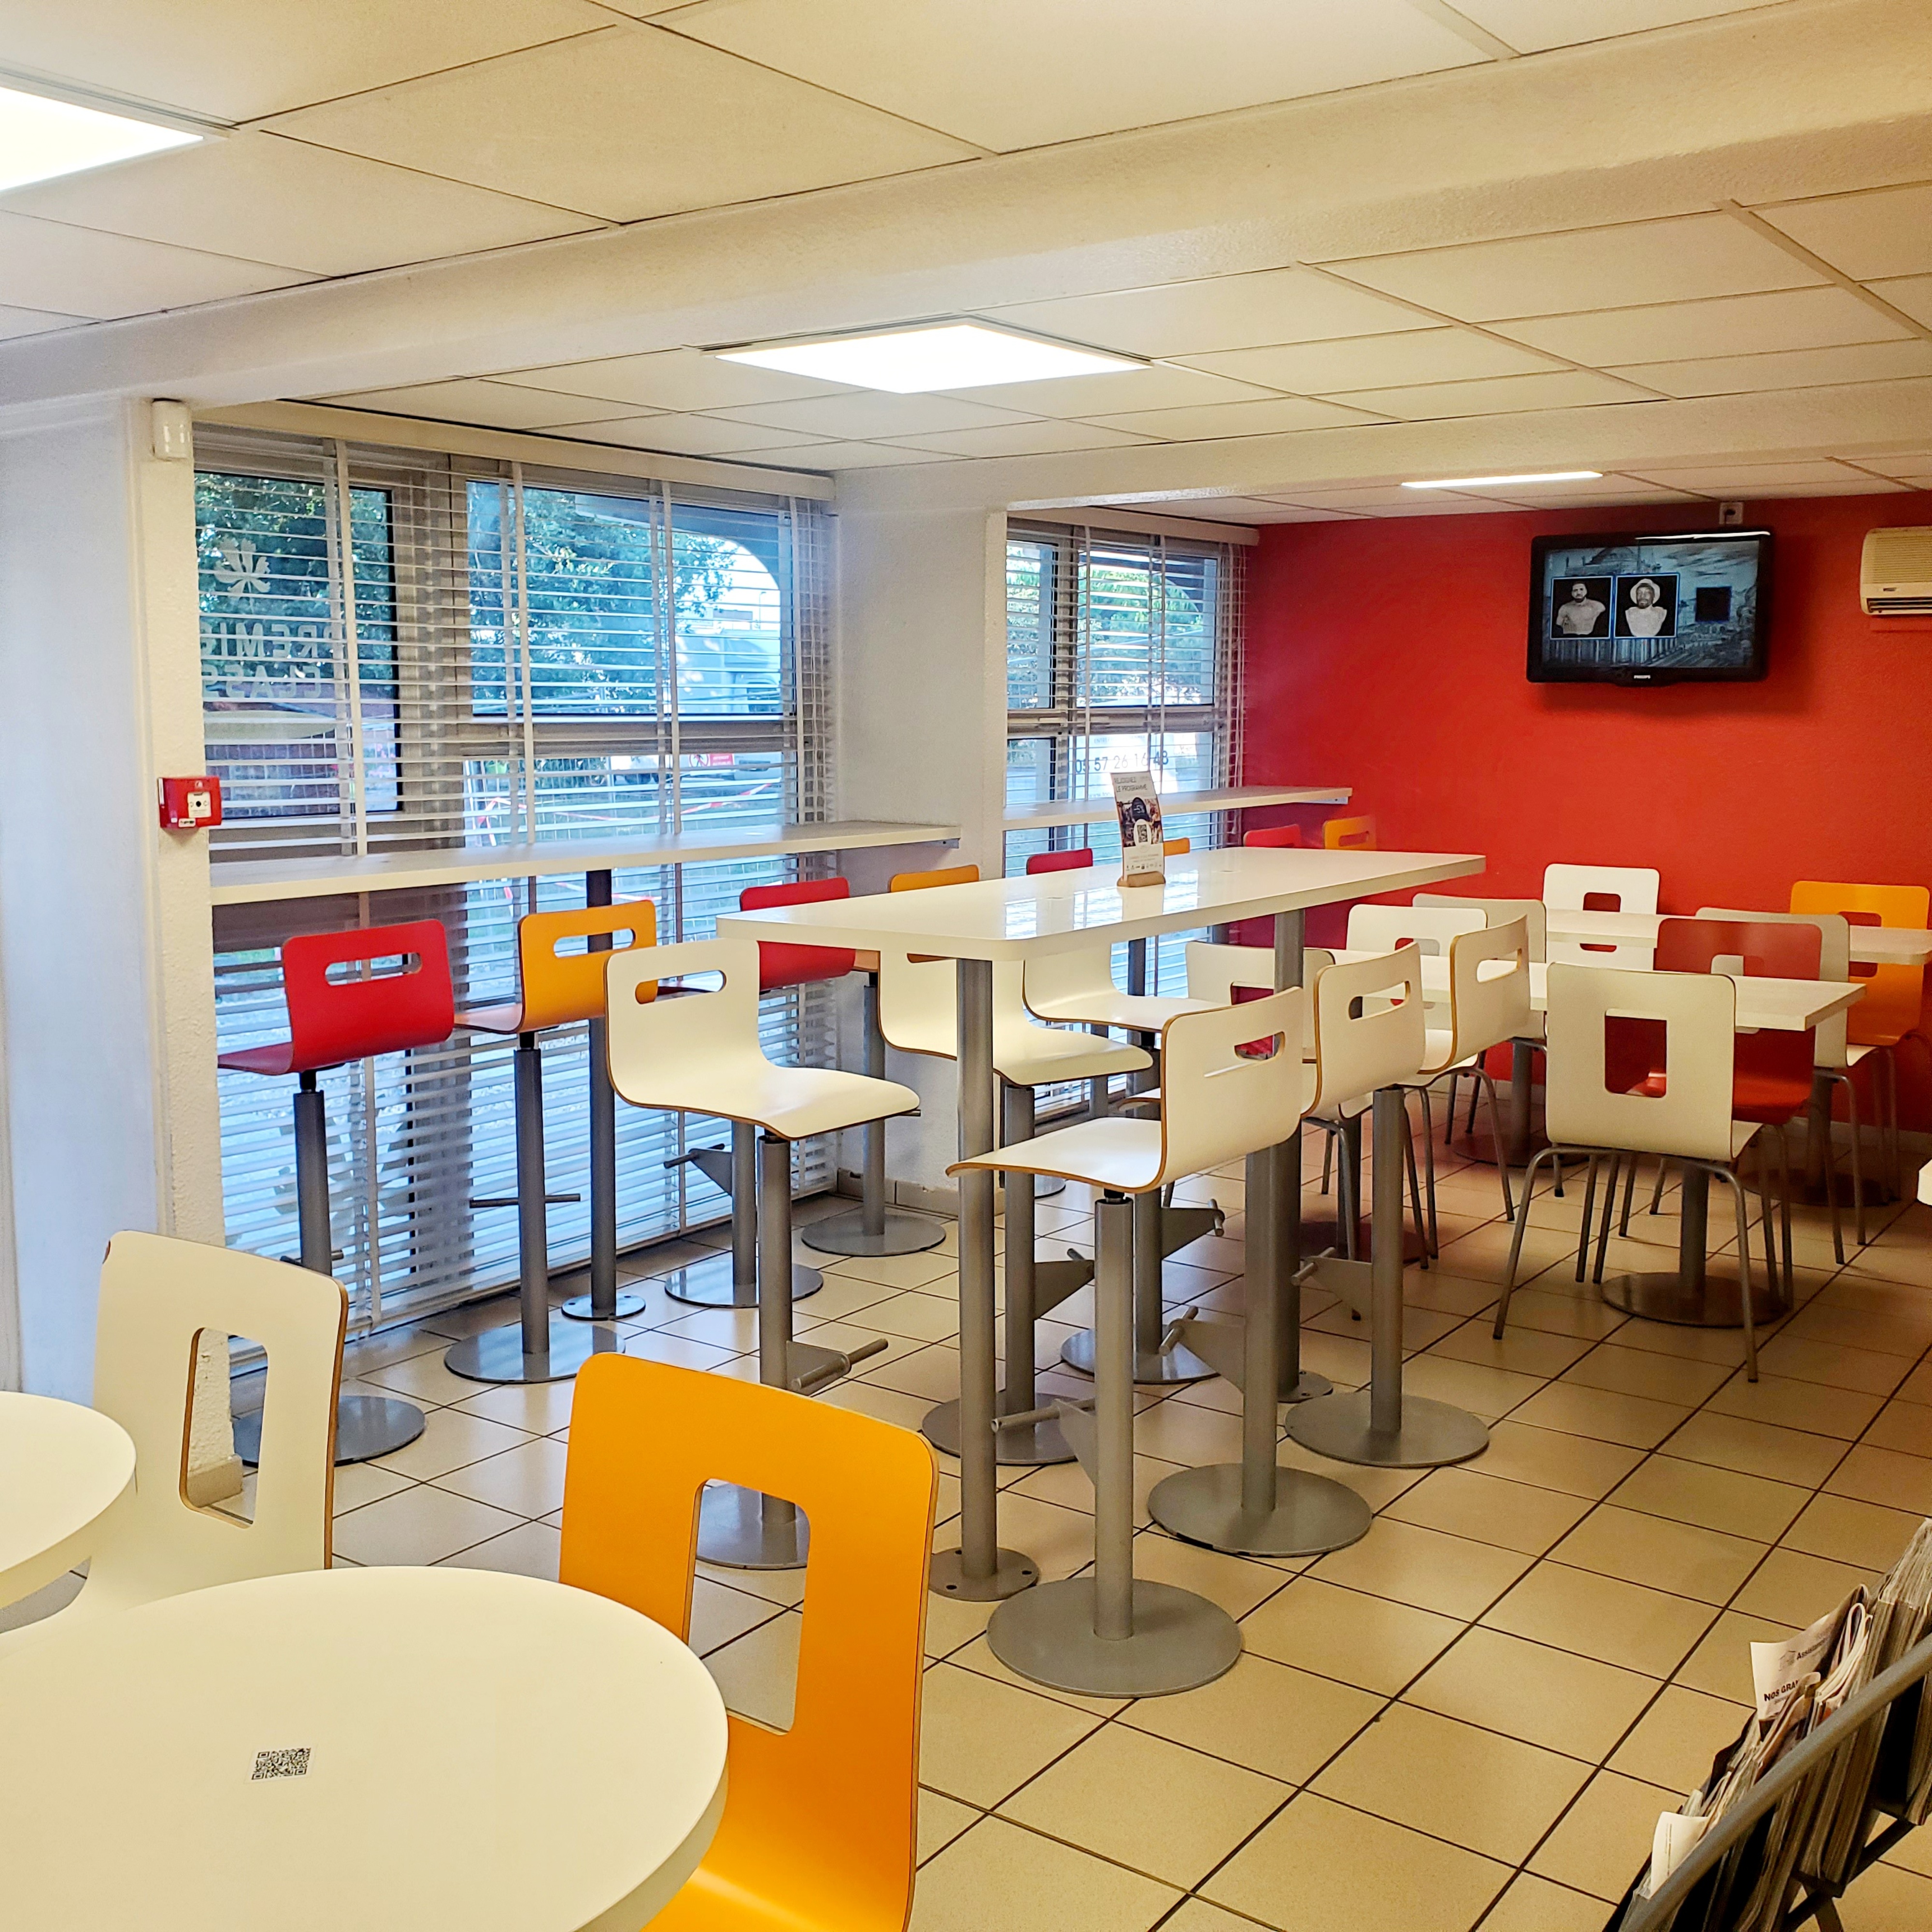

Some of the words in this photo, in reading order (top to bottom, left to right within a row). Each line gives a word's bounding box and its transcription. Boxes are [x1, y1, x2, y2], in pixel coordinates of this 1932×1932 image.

[1094, 756, 1108, 771] 57
[1113, 754, 1128, 769] 26
[1134, 753, 1149, 767] 16
[1153, 751, 1169, 765] 48
[1763, 1689, 1780, 1702] NOS
